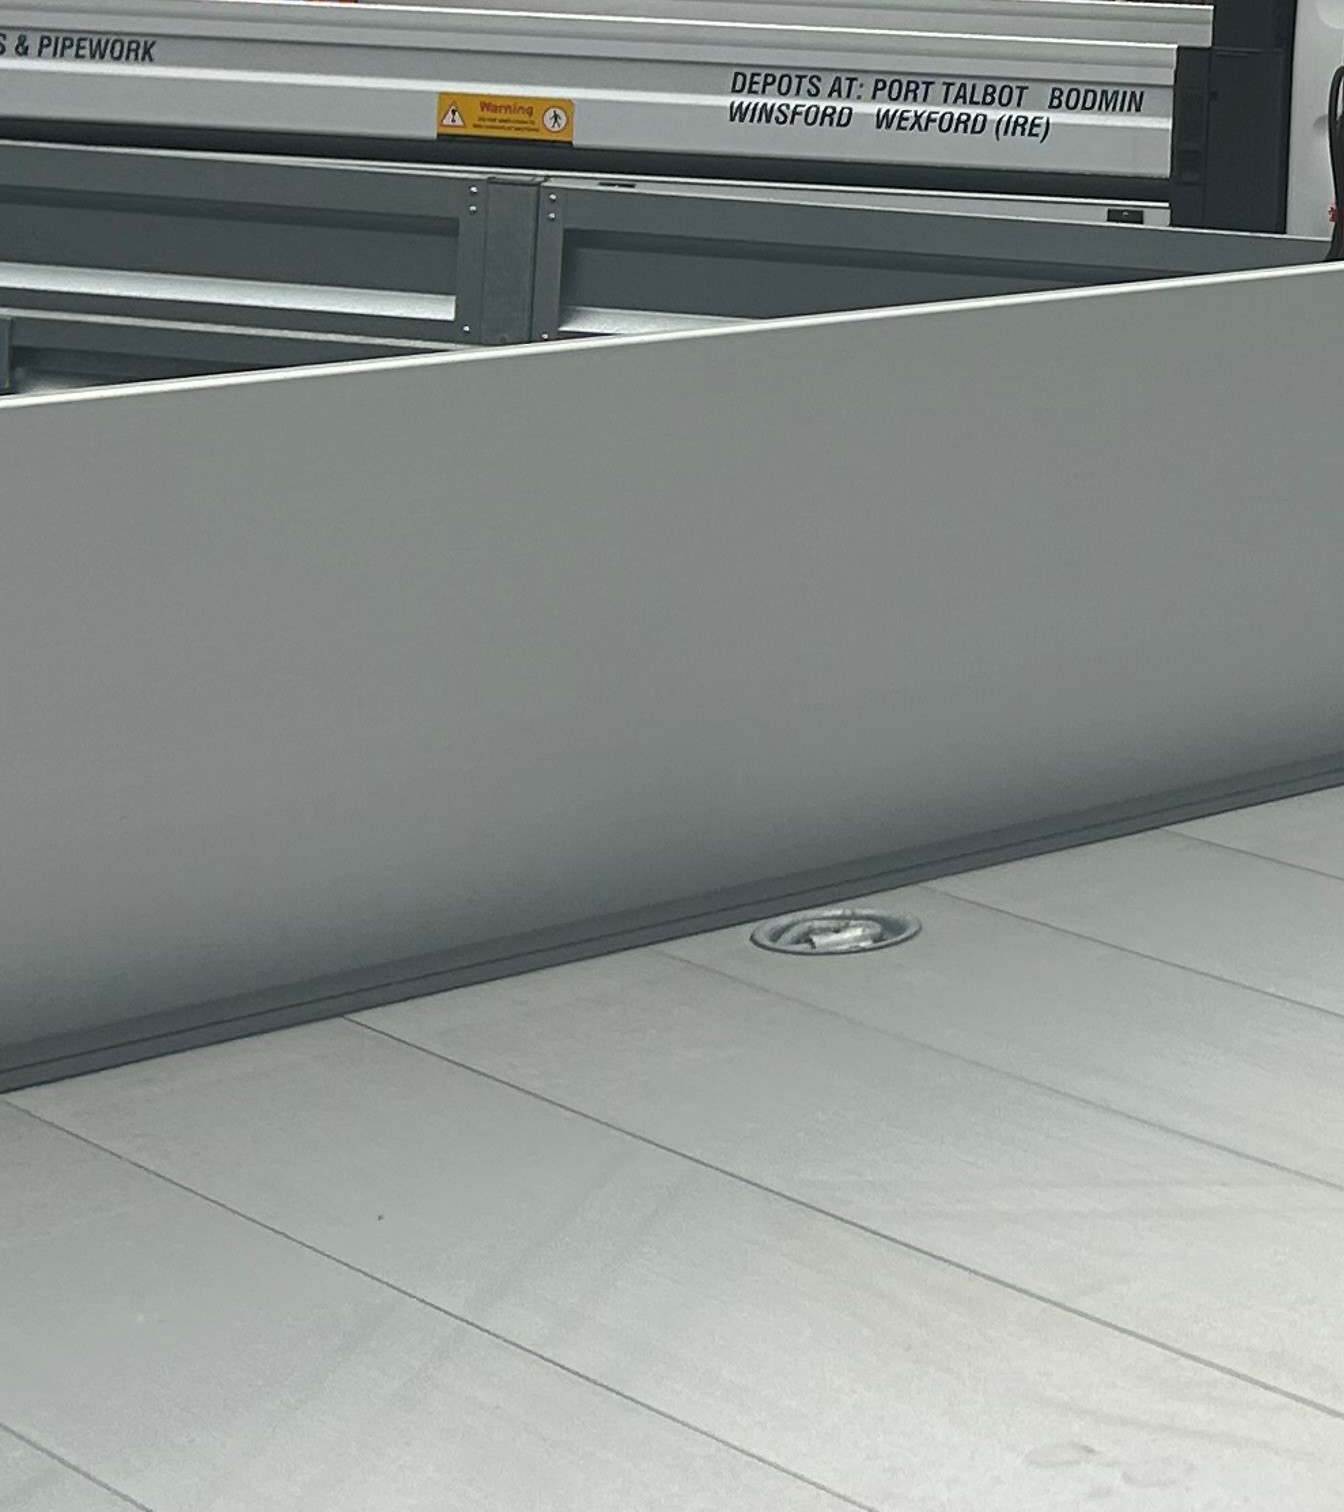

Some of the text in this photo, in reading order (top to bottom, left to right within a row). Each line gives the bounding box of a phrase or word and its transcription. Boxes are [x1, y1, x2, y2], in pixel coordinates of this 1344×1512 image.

[15, 34, 29, 57] &
[37, 35, 158, 63] PIPEWORK
[479, 100, 534, 117] Warning
[732, 71, 1145, 113] DEPOTS AT: PORT TALBOT BODMIN
[728, 101, 1051, 143] WINSFORD WEXFORD (IRE)
